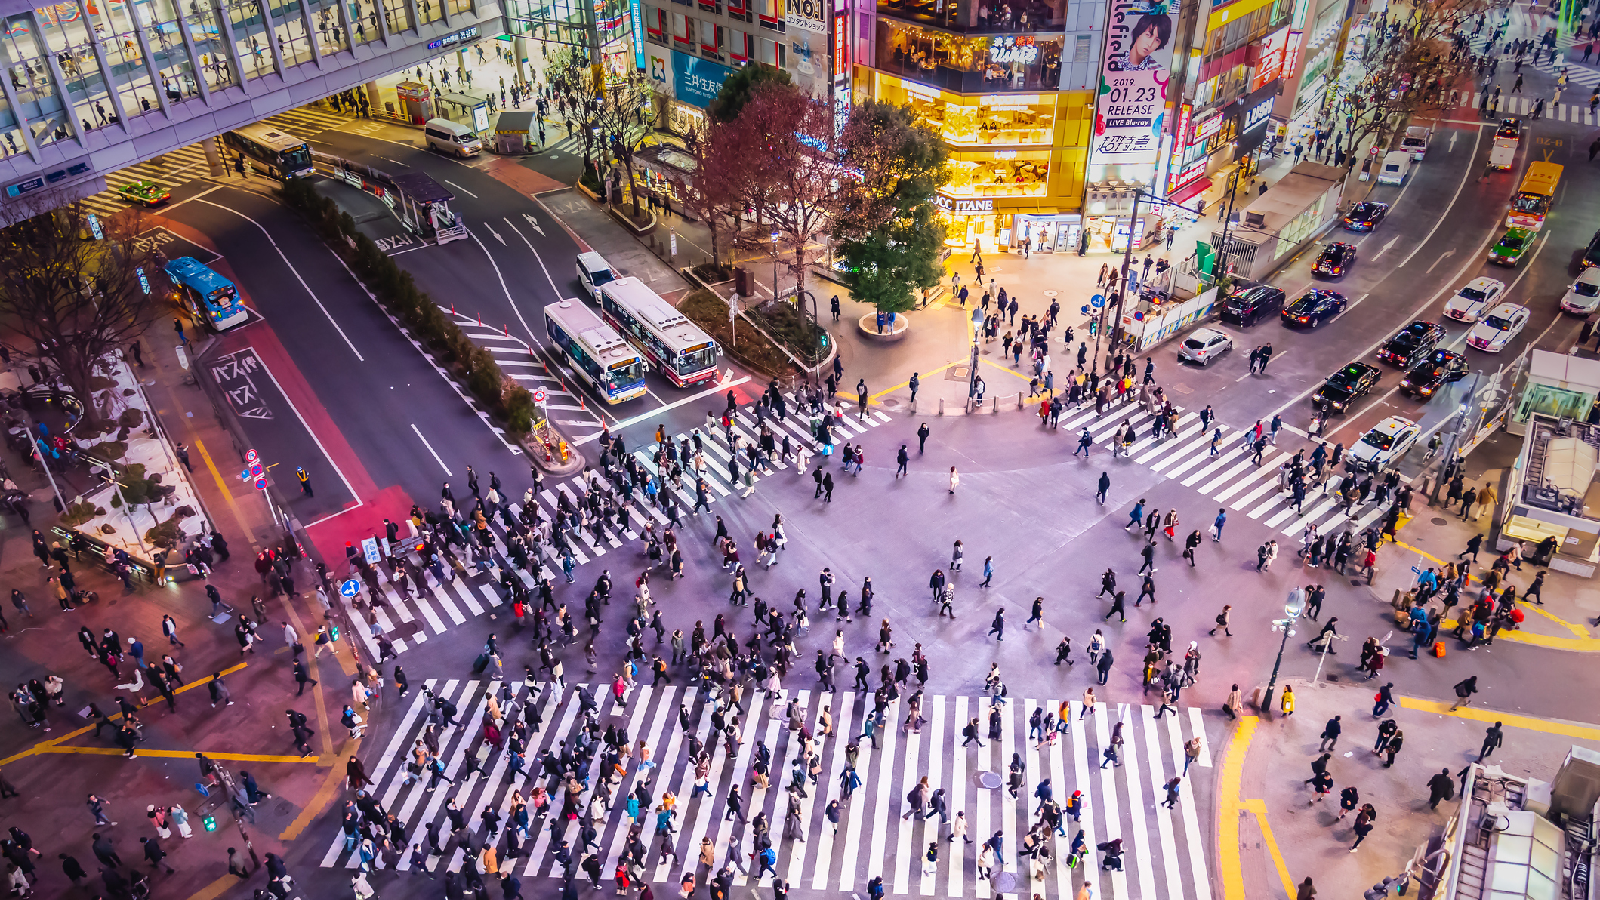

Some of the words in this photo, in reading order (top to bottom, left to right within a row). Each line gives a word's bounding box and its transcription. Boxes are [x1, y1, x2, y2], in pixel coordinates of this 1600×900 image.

[1108, 0, 1133, 72] lefield
[1110, 87, 1156, 103] 01.23
[1107, 104, 1155, 116] RELEASE
[1125, 118, 1150, 127] Blu-ray
